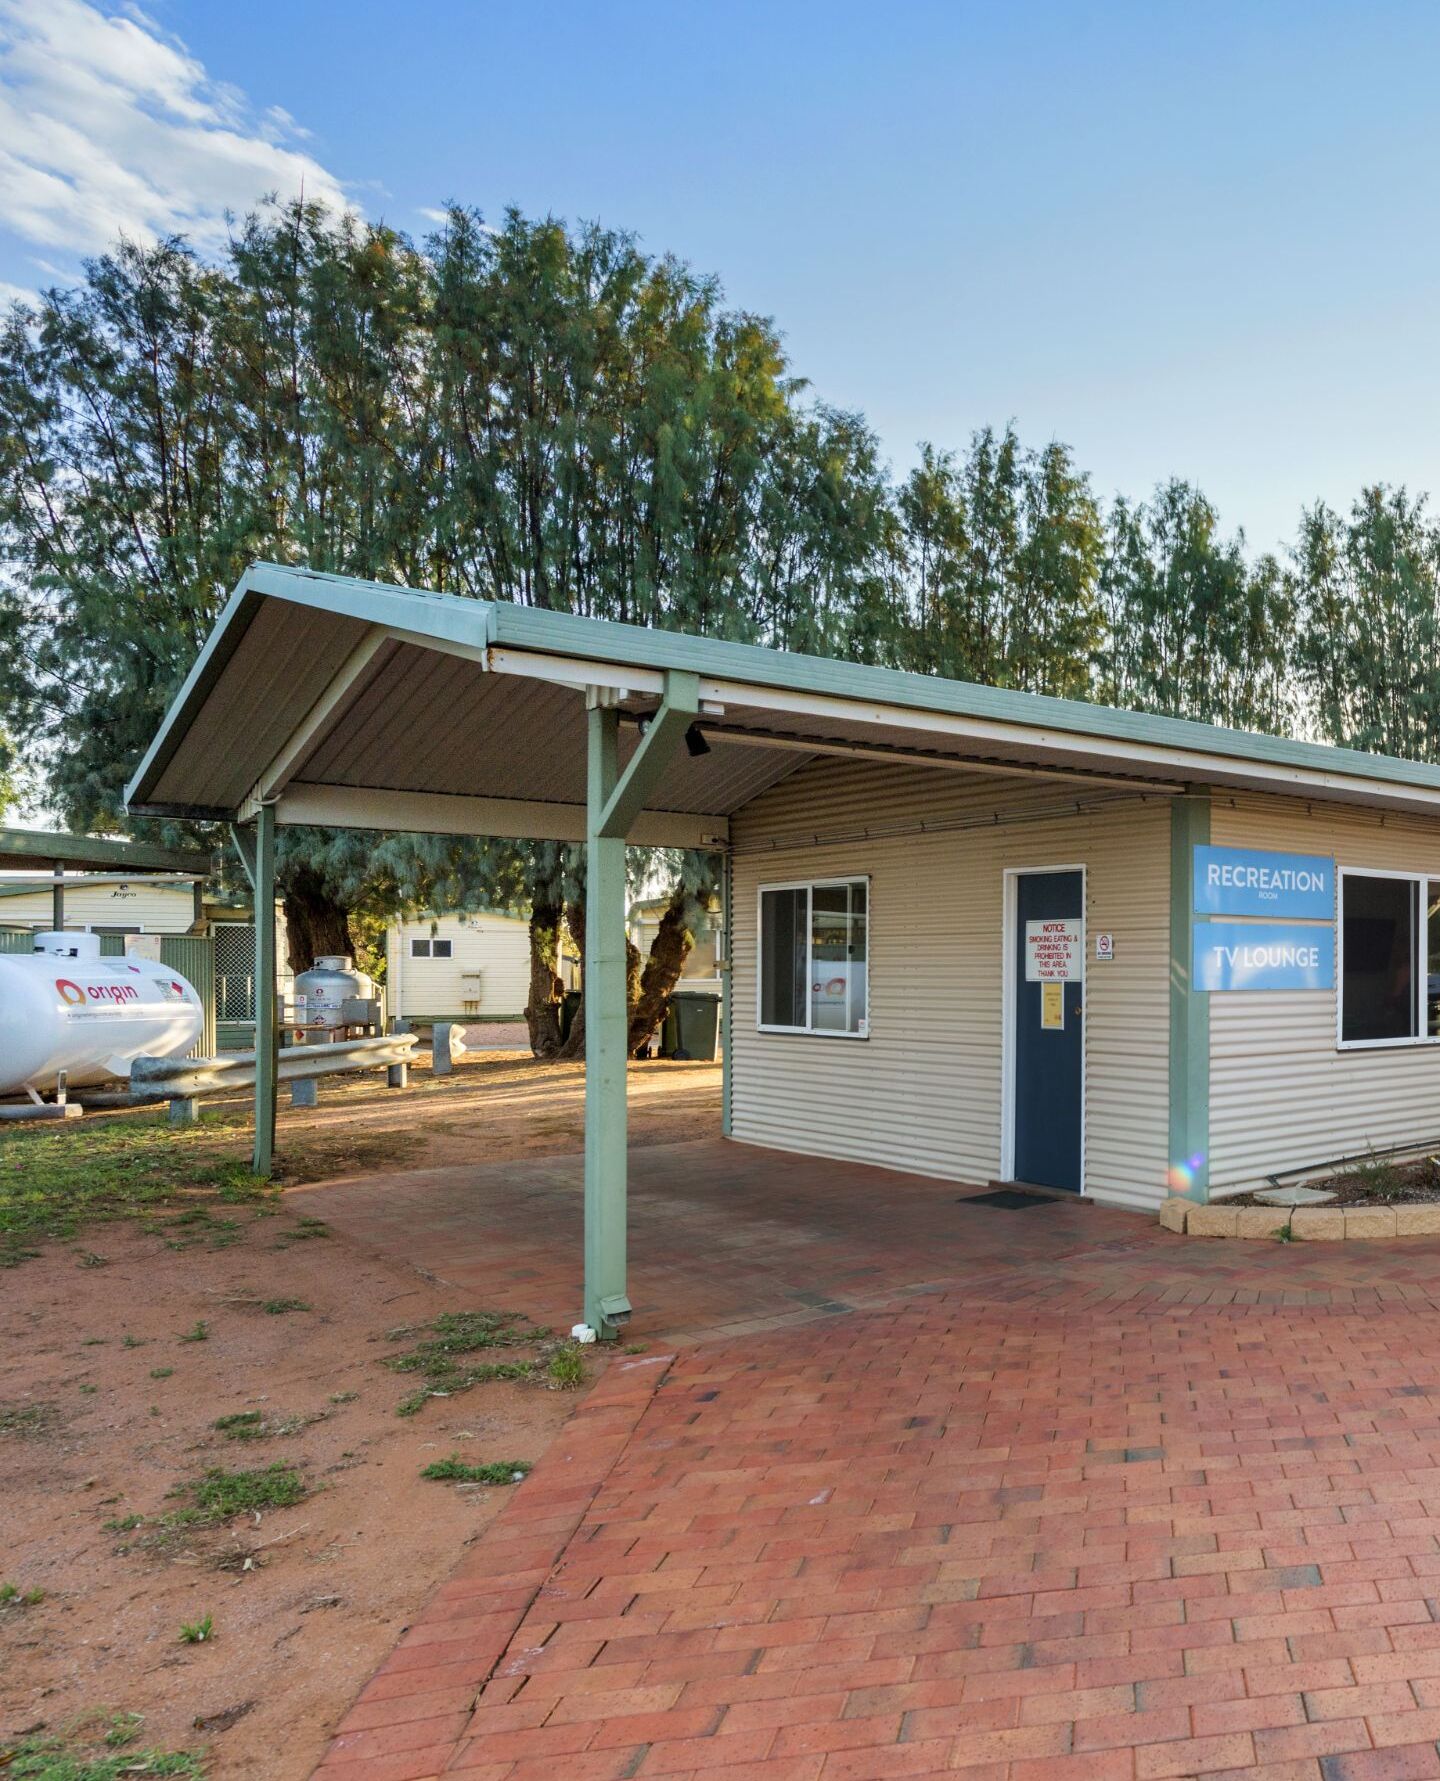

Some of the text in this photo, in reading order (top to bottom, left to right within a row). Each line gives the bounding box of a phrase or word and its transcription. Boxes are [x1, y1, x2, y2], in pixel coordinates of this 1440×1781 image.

[1207, 863, 1325, 892] RECREATION
[1258, 891, 1278, 899] ROOM
[1042, 924, 1066, 932] NOTICE
[1029, 935, 1052, 943] SMOKING
[1213, 946, 1320, 968] TV LOUNGE
[87, 985, 139, 1005] origin
